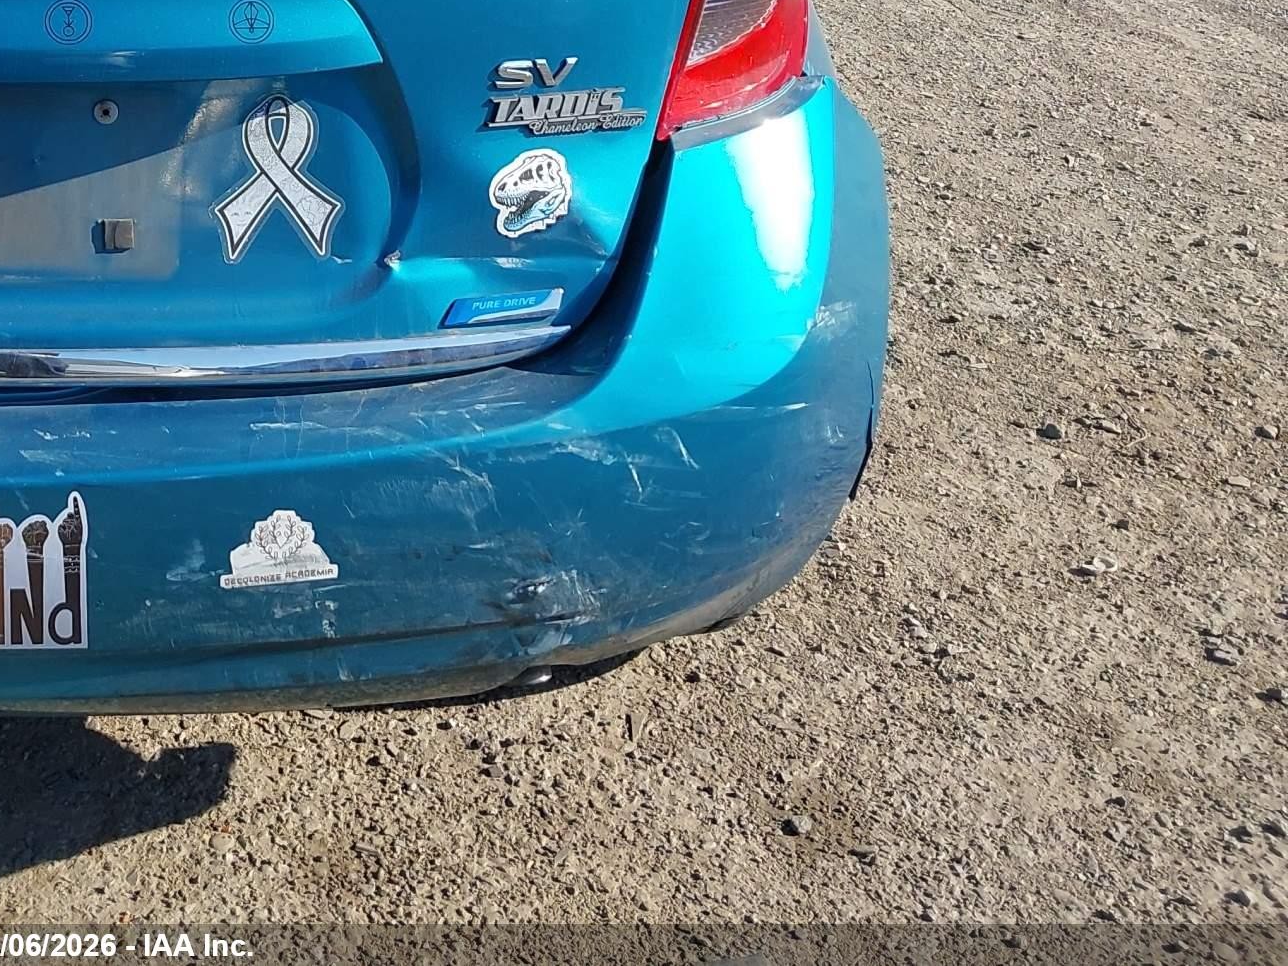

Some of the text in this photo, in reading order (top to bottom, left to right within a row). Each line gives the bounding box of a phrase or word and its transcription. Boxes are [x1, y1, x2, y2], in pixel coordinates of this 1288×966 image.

[495, 57, 578, 89] SV
[529, 114, 646, 135] Chameleon Edition
[472, 296, 537, 310] PURE DRIVE
[224, 568, 333, 586] DECOLONIZE ACADEMIA
